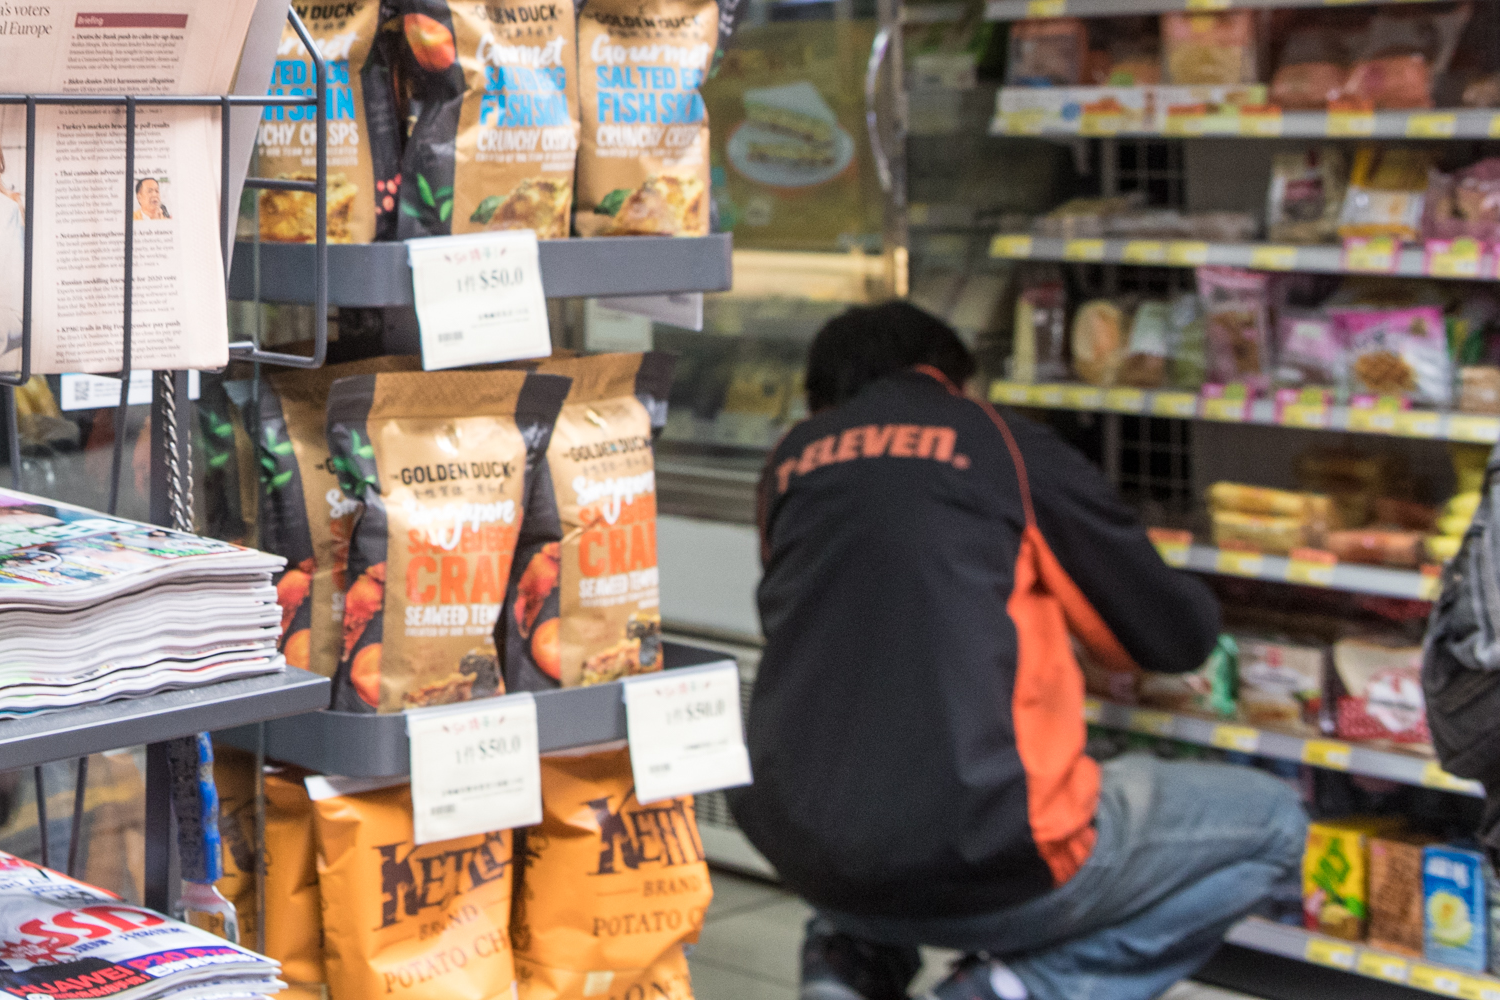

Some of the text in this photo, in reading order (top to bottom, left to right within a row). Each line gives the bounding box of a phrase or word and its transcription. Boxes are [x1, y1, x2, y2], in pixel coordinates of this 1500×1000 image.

[14, 1, 51, 17] voters
[312, 1, 358, 20] DUCK
[518, 4, 558, 24] DUCK
[9, 21, 53, 39] Europe
[596, 66, 676, 92] SALTED
[597, 92, 657, 125] FISH
[479, 267, 524, 291] $50.0
[401, 462, 512, 486] GOLDEN DUCK
[404, 604, 469, 627] SEAWEED
[18, 905, 167, 949] SSD
[591, 909, 686, 940] POTATO
[383, 942, 469, 993] POTATO
[8, 966, 137, 998] HUAWEI
